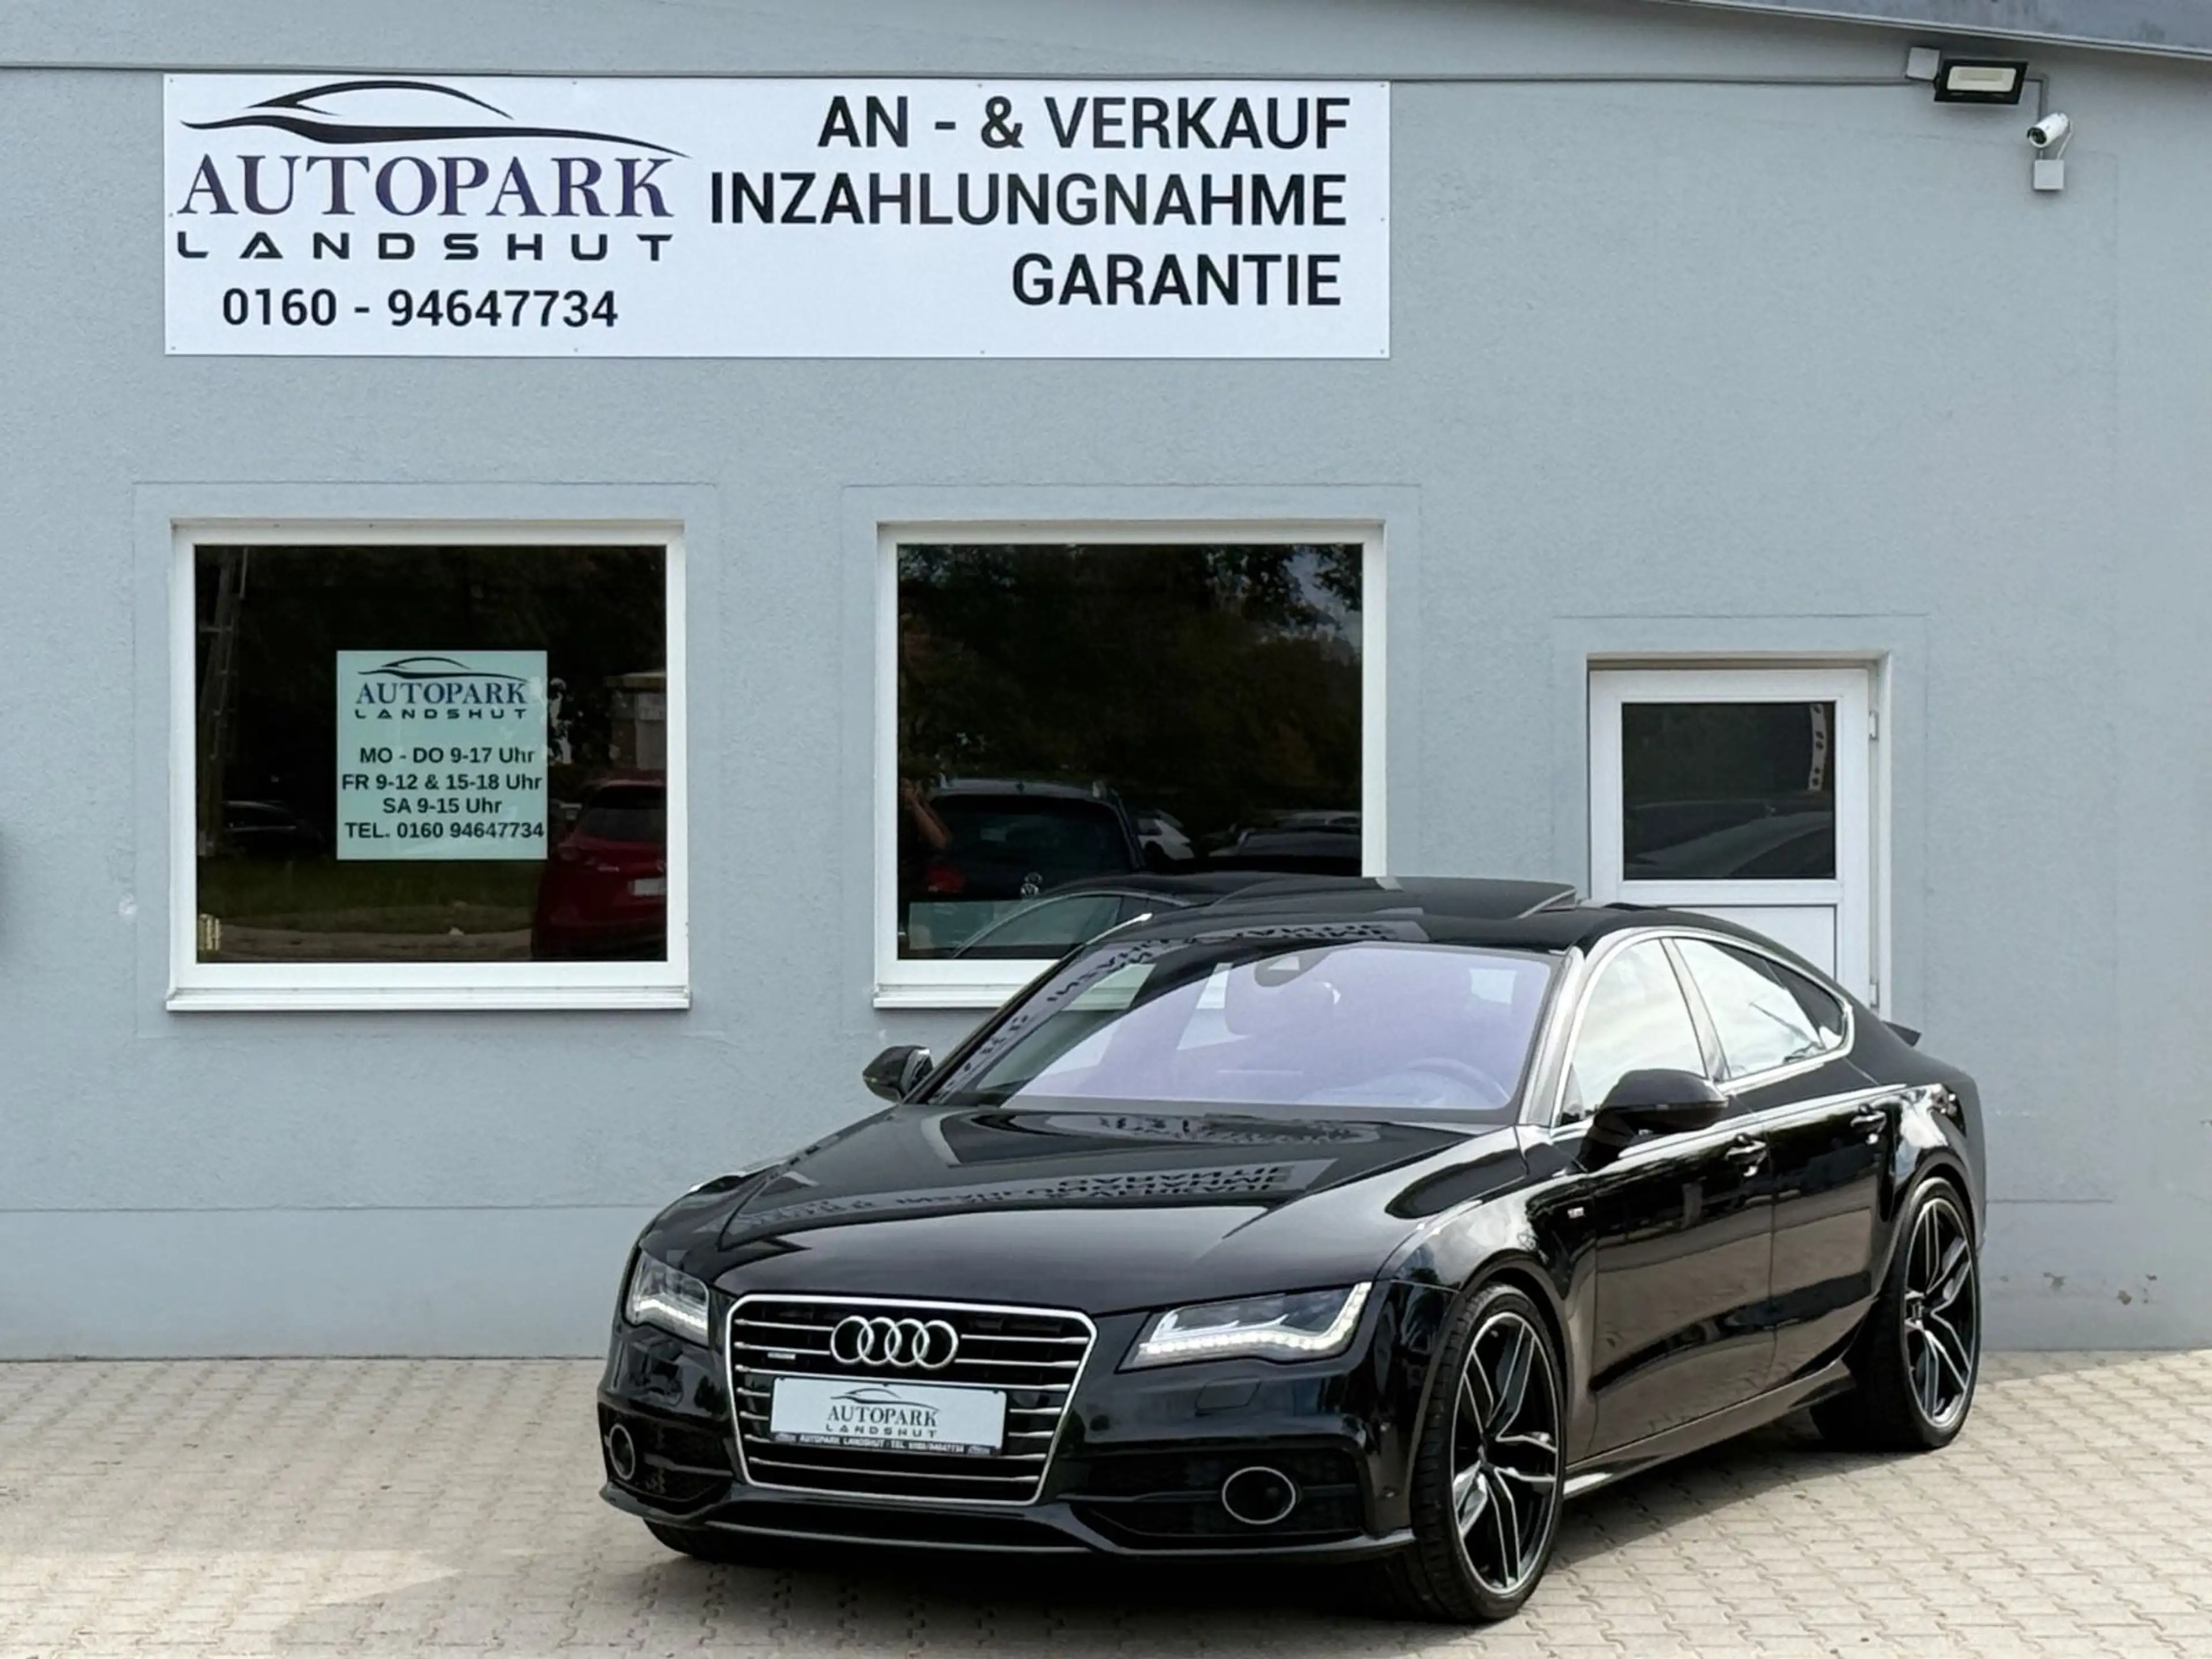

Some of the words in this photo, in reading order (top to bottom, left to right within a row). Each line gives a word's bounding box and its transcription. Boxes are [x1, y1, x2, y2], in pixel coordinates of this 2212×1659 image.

[817, 96, 908, 148] AN
[934, 120, 956, 131] -
[980, 96, 1024, 149] &
[1044, 96, 1350, 149] VERKAUF
[177, 153, 675, 217] AUTOPARK
[711, 172, 1346, 226] INZAHLUNGNAHME
[177, 231, 673, 262] LANDSHUT
[1012, 253, 1341, 306] GARANTIE
[222, 287, 337, 326] 0160
[387, 289, 619, 328] 94647734
[355, 683, 528, 704] AUTOPARK
[355, 709, 528, 719] LANDSHUT
[359, 747, 393, 764] MO
[413, 747, 444, 763] DO
[450, 747, 493, 763] 9-17
[499, 746, 535, 763] Uhr
[342, 774, 369, 790] FR
[376, 774, 418, 790] 9-12
[425, 774, 439, 790] &
[446, 774, 500, 790] 15-18
[506, 773, 543, 790] Uhr
[382, 797, 412, 813] SA
[417, 797, 460, 813] 9-15
[466, 797, 502, 813] Uhr
[344, 822, 391, 838] TEL.
[396, 822, 444, 838] 0160
[449, 821, 544, 838] 94647734
[827, 1405, 939, 1427] AUTOPARK
[826, 1424, 937, 1438] LANDSHUT
